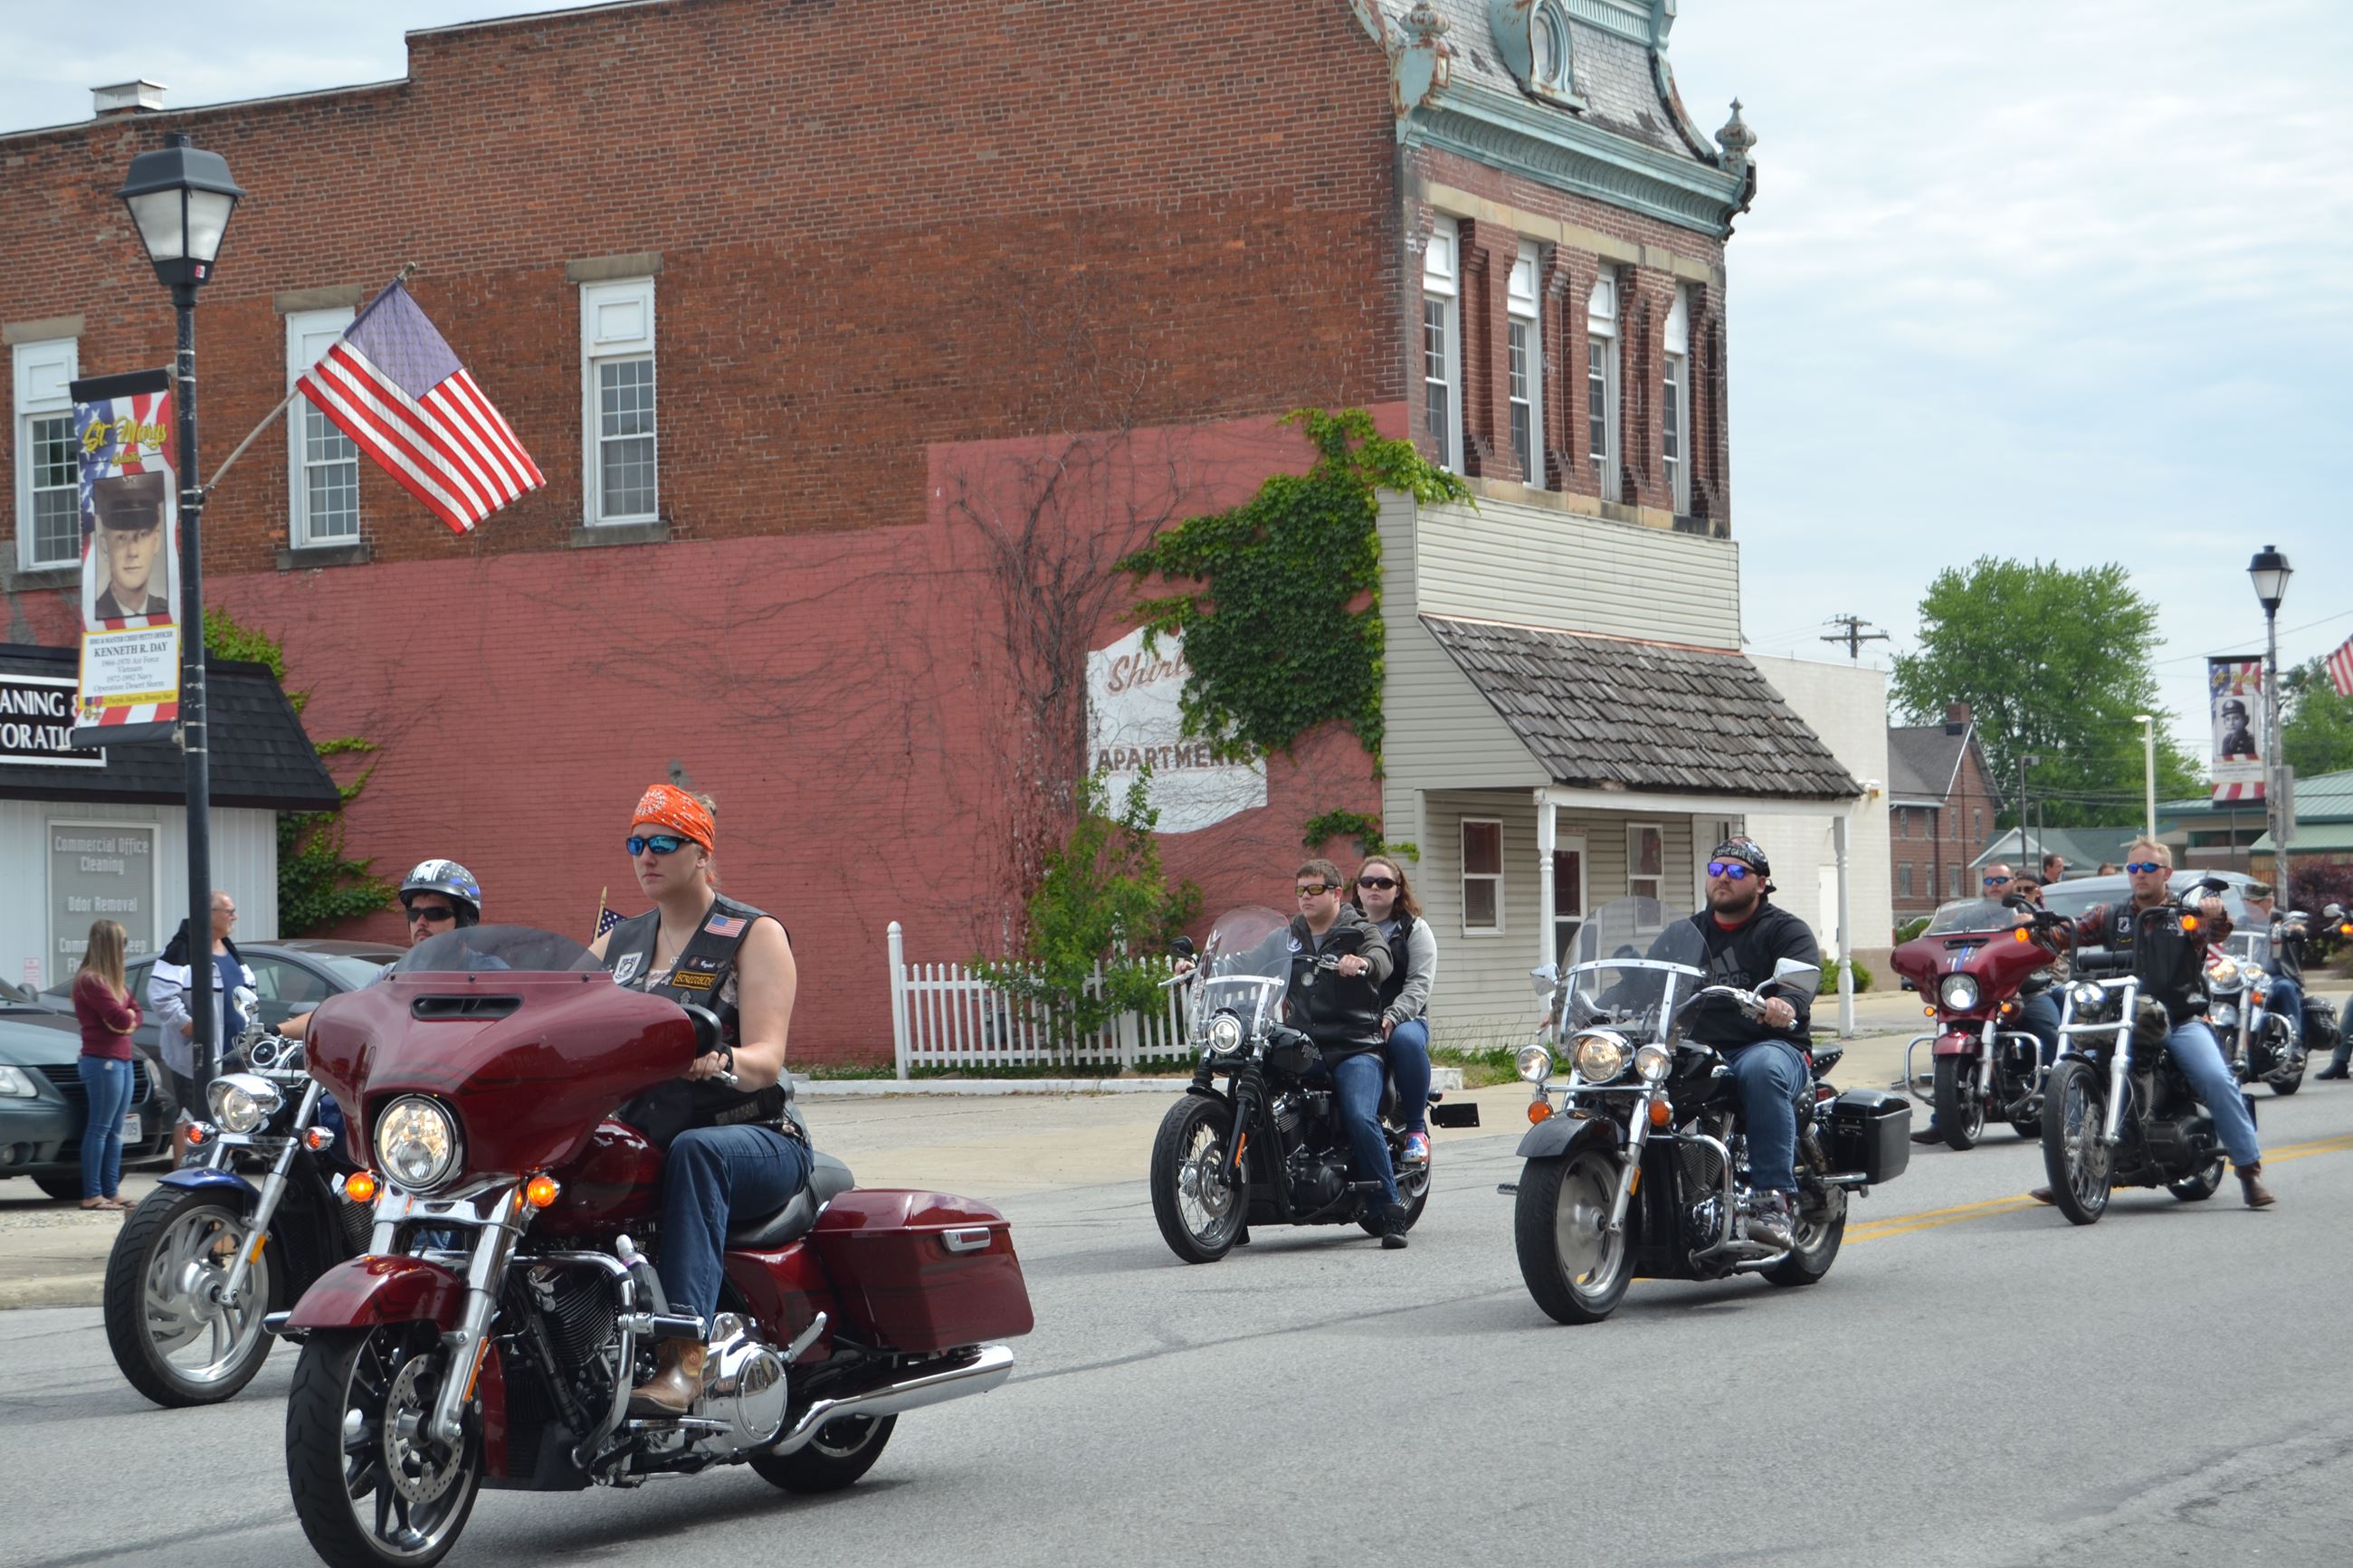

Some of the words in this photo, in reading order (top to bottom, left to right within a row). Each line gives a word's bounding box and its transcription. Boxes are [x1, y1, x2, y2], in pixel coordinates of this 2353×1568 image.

[82, 420, 112, 452] St.
[113, 415, 167, 450] Marys
[94, 644, 138, 658] KENNETH
[139, 643, 148, 654] R.
[150, 641, 168, 652] DAY
[143, 656, 159, 664] Force
[1108, 651, 1191, 692] Shirl
[93, 683, 124, 693] Operation
[125, 681, 145, 689] Desert
[55, 836, 116, 852] Commercial
[119, 838, 148, 855] Office
[81, 856, 124, 875] Cleaning
[68, 896, 91, 912] Odor
[94, 896, 138, 912] Removal
